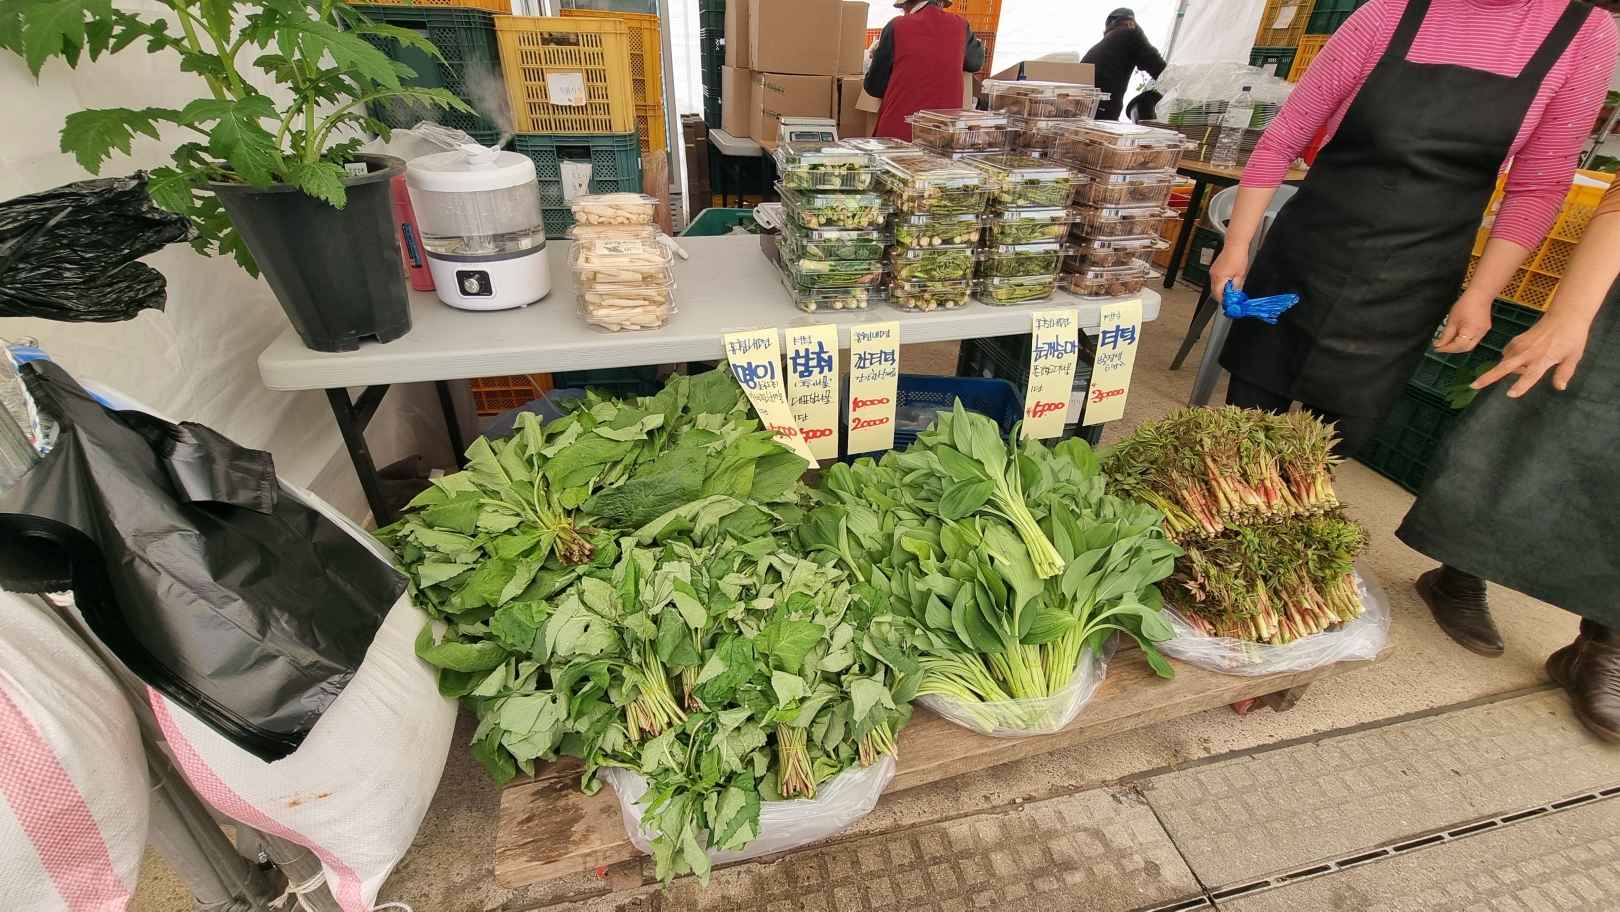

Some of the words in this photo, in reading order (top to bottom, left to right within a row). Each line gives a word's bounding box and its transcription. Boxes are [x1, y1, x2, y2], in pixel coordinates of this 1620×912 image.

[1100, 325, 1136, 350] 더덕
[731, 360, 776, 390] 명이
[852, 397, 890, 412] 10000
